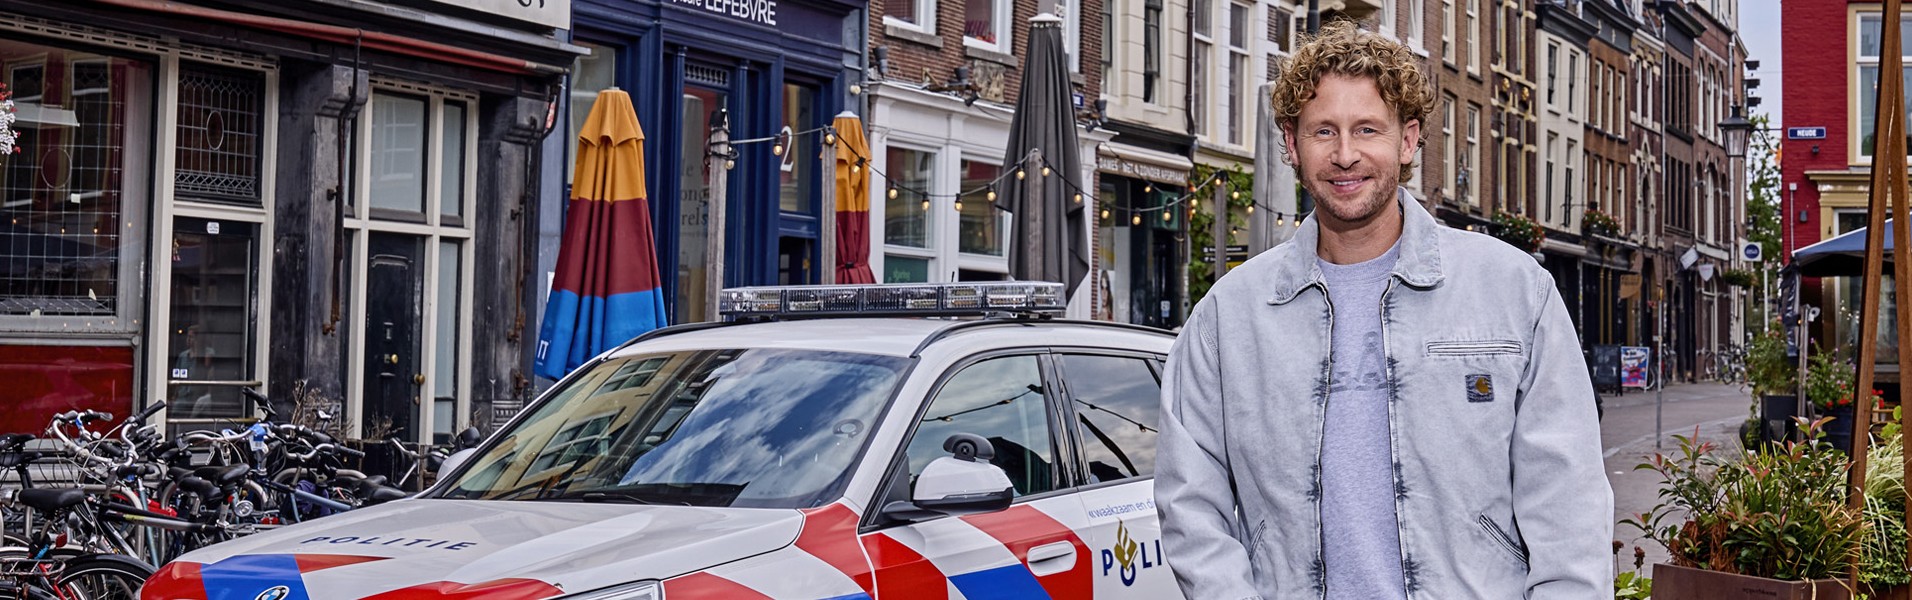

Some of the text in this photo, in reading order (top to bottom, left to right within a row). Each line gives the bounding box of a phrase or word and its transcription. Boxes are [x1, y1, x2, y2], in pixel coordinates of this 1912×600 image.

[1796, 129, 1817, 137] NEUDE
[780, 125, 793, 172] 2
[1136, 502, 1148, 511] en
[300, 536, 478, 551] POLITIE
